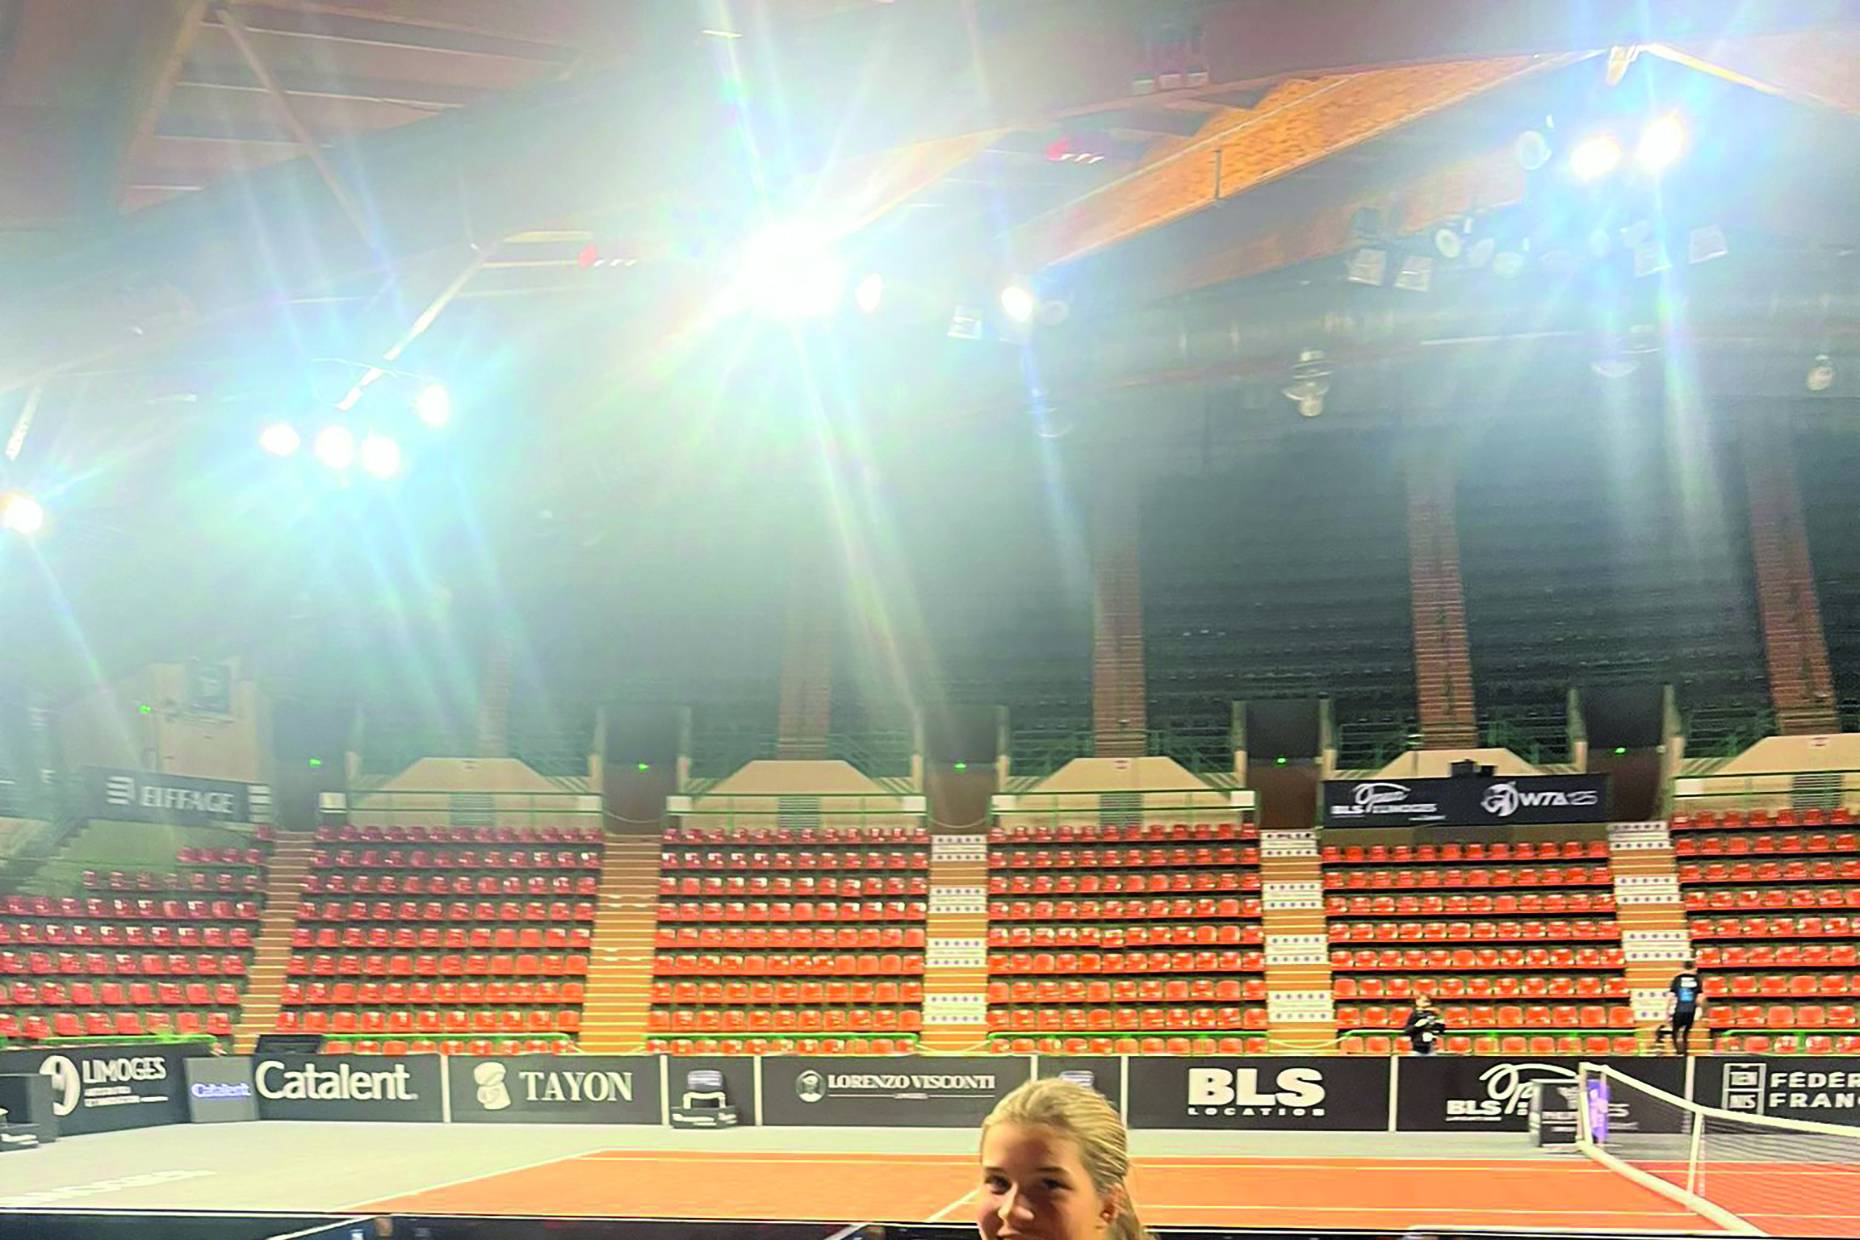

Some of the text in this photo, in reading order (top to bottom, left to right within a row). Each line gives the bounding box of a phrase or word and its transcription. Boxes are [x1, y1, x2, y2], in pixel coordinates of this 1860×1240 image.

[141, 786, 235, 813] EIFFAGE
[82, 1056, 167, 1084] LIMOGES
[255, 1060, 412, 1100] Catalent
[828, 1074, 996, 1089] LORENZO VISCONTI
[519, 1071, 633, 1101] TAYON
[1188, 1067, 1326, 1107] BLS
[1187, 1107, 1326, 1116] LOCATION
[1446, 1100, 1502, 1116] BLS
[1768, 1092, 1860, 1108] FRAN
